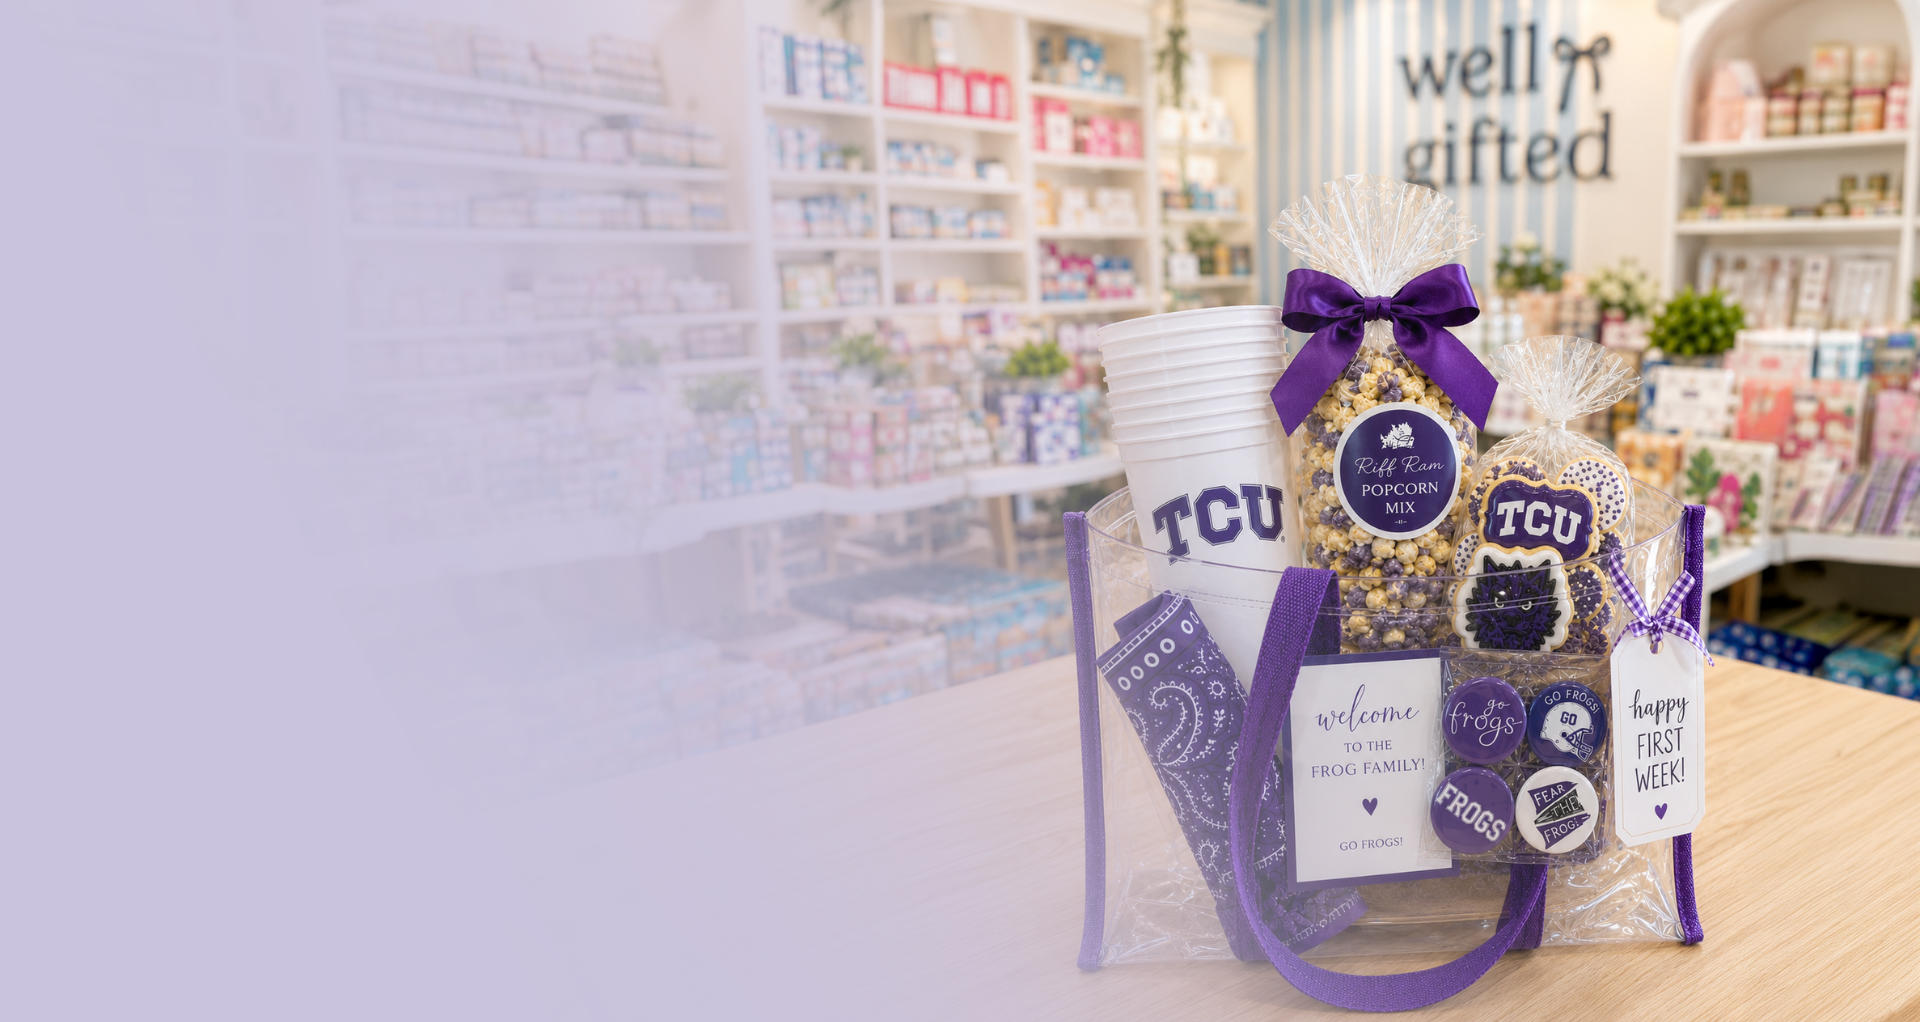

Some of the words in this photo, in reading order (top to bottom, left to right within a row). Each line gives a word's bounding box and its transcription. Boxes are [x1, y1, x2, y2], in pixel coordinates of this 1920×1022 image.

[1399, 22, 1539, 98] well
[1404, 108, 1613, 192] gifted
[1354, 457, 1397, 478] Riff
[1401, 455, 1445, 473] Ram
[1361, 481, 1439, 497] POPCORN
[1385, 501, 1416, 515] MIX
[1152, 483, 1284, 566] TCU
[1496, 499, 1583, 545] TCU
[1314, 683, 1420, 733] welcome
[1483, 698, 1511, 717] go
[1544, 690, 1561, 705] GO
[1566, 689, 1601, 714] FROGS!
[1628, 688, 1690, 726] happy
[1448, 701, 1523, 747] frogs
[1560, 711, 1578, 726] GO
[1343, 742, 1363, 753] TO
[1366, 739, 1393, 752] THE
[1637, 726, 1684, 760] FIRST
[1311, 763, 1357, 779] FROG
[1363, 757, 1426, 775] FAMILY!
[1635, 756, 1686, 793] WEEK!
[1533, 784, 1566, 807] FEAR
[1550, 795, 1579, 817] THE
[1434, 781, 1507, 842] FROGS
[1339, 840, 1358, 852] GO
[1361, 837, 1404, 850] FROGS!
